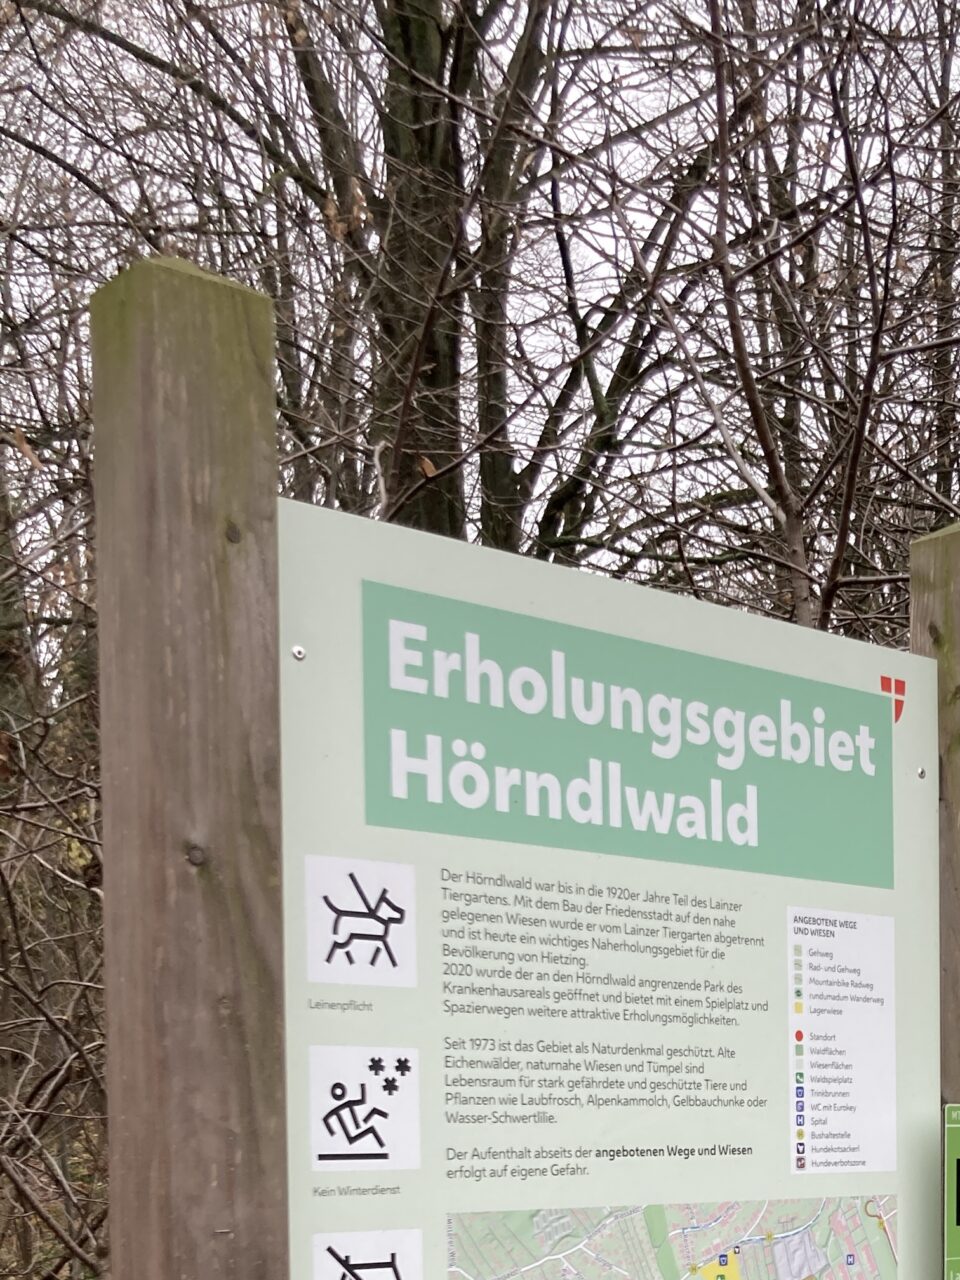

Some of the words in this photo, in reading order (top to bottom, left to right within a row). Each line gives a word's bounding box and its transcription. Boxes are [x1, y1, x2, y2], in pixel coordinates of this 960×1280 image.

[389, 619, 875, 776] Erholungsgebiet
[389, 728, 758, 847] Hörndlwald
[440, 867, 463, 882] Der
[465, 871, 532, 889] Hörndlwald
[534, 882, 555, 891] war
[557, 880, 573, 894] bis
[575, 882, 585, 895] in
[587, 884, 604, 897] die
[606, 886, 640, 900] 1920er
[642, 890, 670, 904] Jahre
[672, 892, 689, 906] Teil
[690, 895, 708, 908] des
[709, 897, 743, 911] Lainzer
[441, 886, 511, 906] Tiergartens.
[513, 894, 533, 908] Mit
[534, 896, 560, 910] dem
[561, 898, 583, 913] Bau
[584, 901, 603, 914] der
[605, 903, 673, 921] Friedensstadt
[674, 911, 691, 923] auf
[692, 912, 711, 925] den
[712, 915, 736, 927] nahe
[441, 907, 503, 924] gelegenen
[505, 911, 547, 927] Wiesen
[549, 918, 584, 930] wurde
[585, 922, 597, 931] er
[598, 924, 622, 933] vom
[624, 923, 660, 937] Lainzer
[662, 926, 712, 943] Tiergarten
[713, 931, 764, 946] abgetrennt
[793, 915, 838, 927] ANGEBOTENE
[838, 920, 857, 929] WEGE
[793, 926, 809, 935] UND
[809, 928, 835, 937] WIESEN
[441, 926, 465, 939] und
[467, 927, 482, 940] ist
[483, 927, 517, 943] heute
[519, 932, 537, 944] ein
[538, 934, 589, 951] wichtiges
[591, 937, 693, 958] Naherholungsgebiet
[695, 945, 709, 958] für
[711, 947, 726, 960] die
[442, 943, 515, 964] Bevölkerung
[517, 953, 538, 962] von
[540, 951, 589, 969] Hietzing.
[808, 948, 834, 960] Gehweg
[808, 962, 823, 971] Rad-
[823, 964, 836, 972] und
[836, 964, 861, 976] Gehweg
[442, 962, 473, 976] 2020
[475, 966, 512, 979] wurde
[514, 967, 534, 980] der
[535, 971, 550, 981] an
[552, 970, 573, 982] den
[575, 971, 636, 986] Hörndlwald
[638, 979, 702, 991] angrenzende
[703, 979, 725, 992] Park
[726, 981, 743, 993] des
[808, 977, 850, 987] Mountainbike
[850, 979, 874, 991] Radweg
[442, 981, 550, 999] Krankenhausareals
[552, 988, 600, 1003] geöffnet
[602, 991, 622, 1003] und
[624, 991, 654, 1005] bietet
[655, 994, 672, 1005] mit
[674, 995, 703, 1007] einem
[705, 996, 749, 1011] Spielplatz
[751, 1000, 769, 1011] und
[308, 999, 373, 1012] Leinenpflicht
[443, 999, 525, 1018] Spazierwegen
[527, 1005, 568, 1017] weitere
[570, 1007, 620, 1020] attraktive
[623, 1008, 739, 1027] Erholungsmöglichkeiten.
[809, 1006, 843, 1016] Lagerwiese
[809, 1032, 836, 1041] Standort
[443, 1036, 467, 1049] Seit
[469, 1037, 496, 1051] 1973
[498, 1039, 512, 1051] ist
[513, 1039, 534, 1052] das
[536, 1039, 573, 1053] Gebiet
[574, 1041, 590, 1053] als
[591, 1042, 664, 1055] Naturdenkmal
[666, 1045, 715, 1060] geschützt.
[717, 1046, 736, 1058] Alte
[444, 1055, 524, 1070] Eichenwälder,
[526, 1058, 582, 1071] naturnahe
[583, 1059, 622, 1072] Wiesen
[624, 1060, 644, 1072] und
[646, 1060, 683, 1075] Tümpel
[684, 1062, 705, 1073] sind
[444, 1074, 516, 1087] Lebensraum
[518, 1075, 535, 1087] für
[537, 1076, 565, 1088] stark
[567, 1076, 625, 1092] gefährdete
[627, 1077, 647, 1089] und
[649, 1078, 702, 1093] geschützte
[703, 1078, 728, 1090] Tiere
[729, 1079, 748, 1091] und
[444, 1092, 496, 1105] Pflanzen
[498, 1093, 518, 1105] wie
[520, 1093, 584, 1107] Laubfrosch,
[672, 1094, 745, 1107] Gelbbauchunke
[746, 1095, 768, 1107] oder
[810, 1102, 822, 1111] WC
[822, 1103, 832, 1111] mit
[445, 1110, 558, 1123] Wasser-Schwertlilie.
[810, 1116, 828, 1126] Spital
[811, 1131, 851, 1139] Bushaltestelle
[446, 1147, 468, 1160] Der
[471, 1146, 531, 1159] Aufenthalt
[534, 1146, 573, 1158] abseits
[574, 1146, 592, 1158] der
[595, 1145, 665, 1160] angebotenen
[666, 1144, 696, 1159] Wege
[697, 1144, 716, 1155] und
[718, 1144, 753, 1155] Wiesen
[446, 1165, 487, 1181] erfolgt
[488, 1164, 508, 1177] auf
[510, 1165, 548, 1180] eigene
[549, 1163, 590, 1176] Gefahr.
[312, 1186, 336, 1196] Kein
[337, 1184, 400, 1195] Winterdienst
